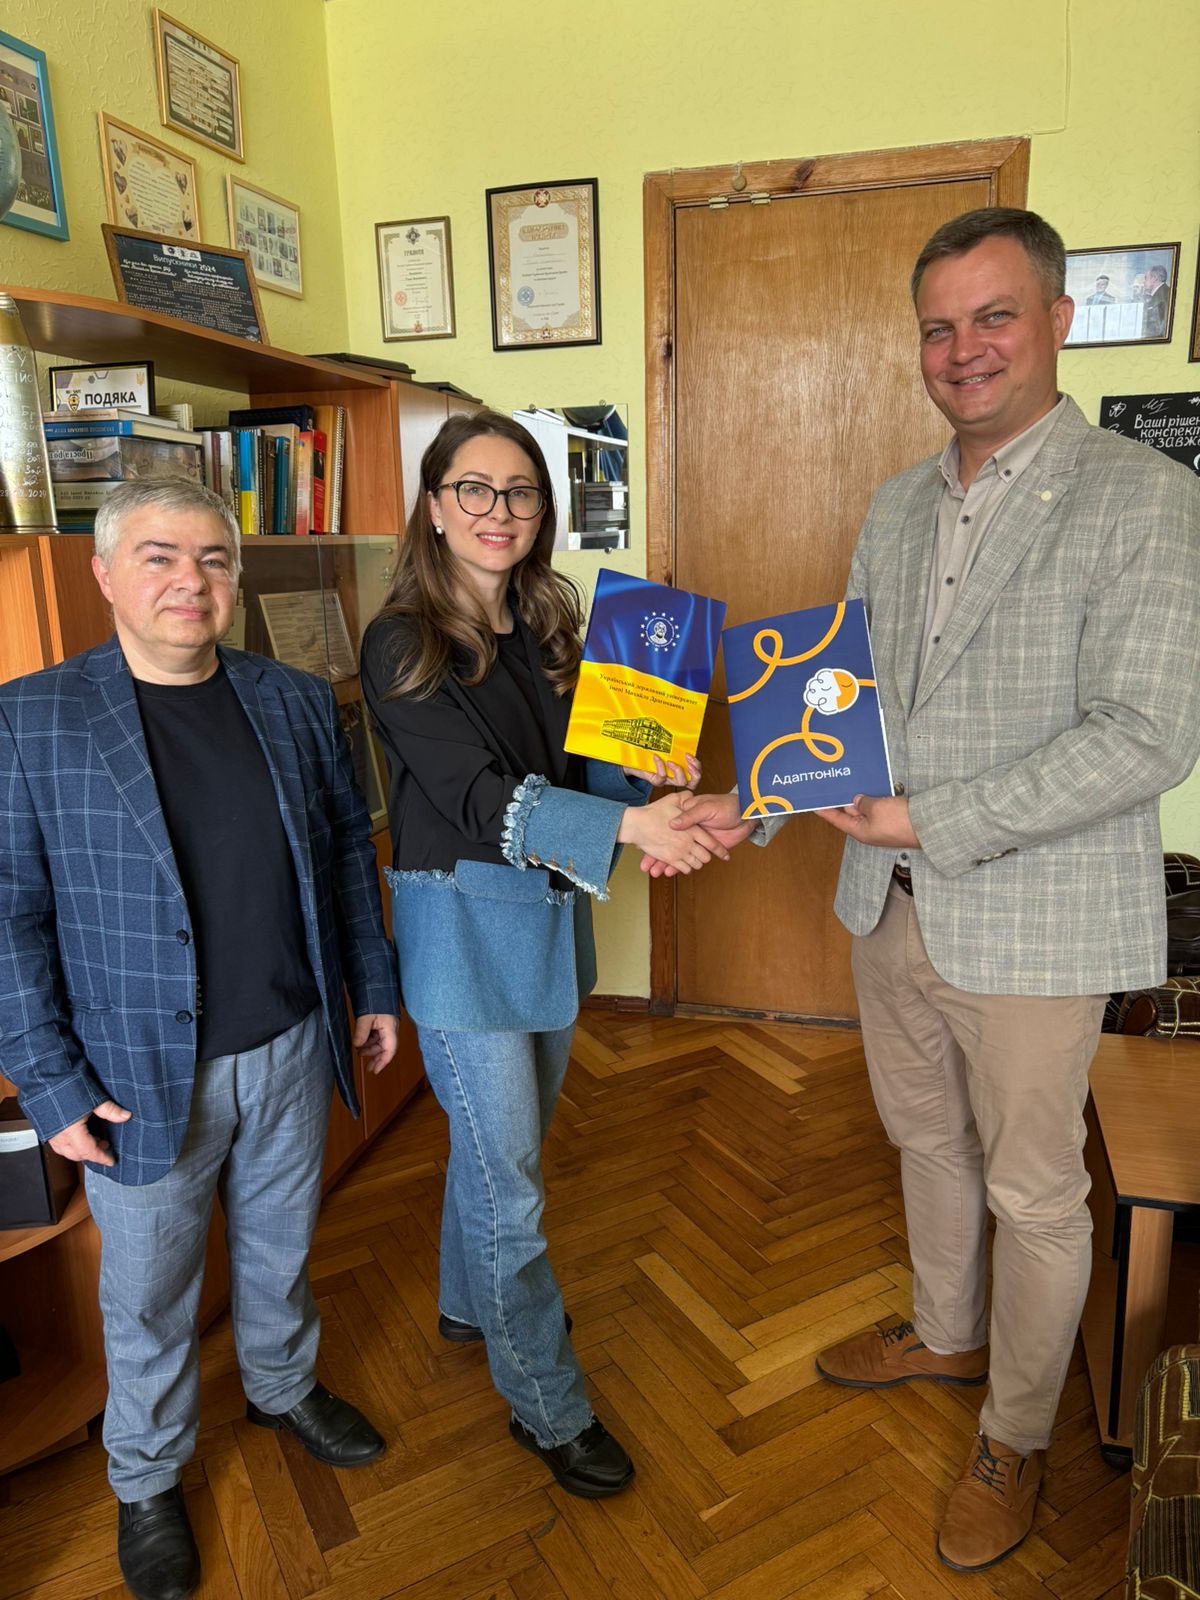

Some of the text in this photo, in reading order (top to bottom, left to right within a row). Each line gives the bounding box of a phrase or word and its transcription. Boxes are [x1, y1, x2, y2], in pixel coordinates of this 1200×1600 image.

[152, 253, 198, 269] Випускники
[198, 263, 217, 273] 2024
[85, 391, 137, 406] ПОДЯКА
[1134, 413, 1167, 429] Ваші
[599, 673, 698, 706] Український державний університет
[609, 684, 685, 711] імені Михайла Драгоманова
